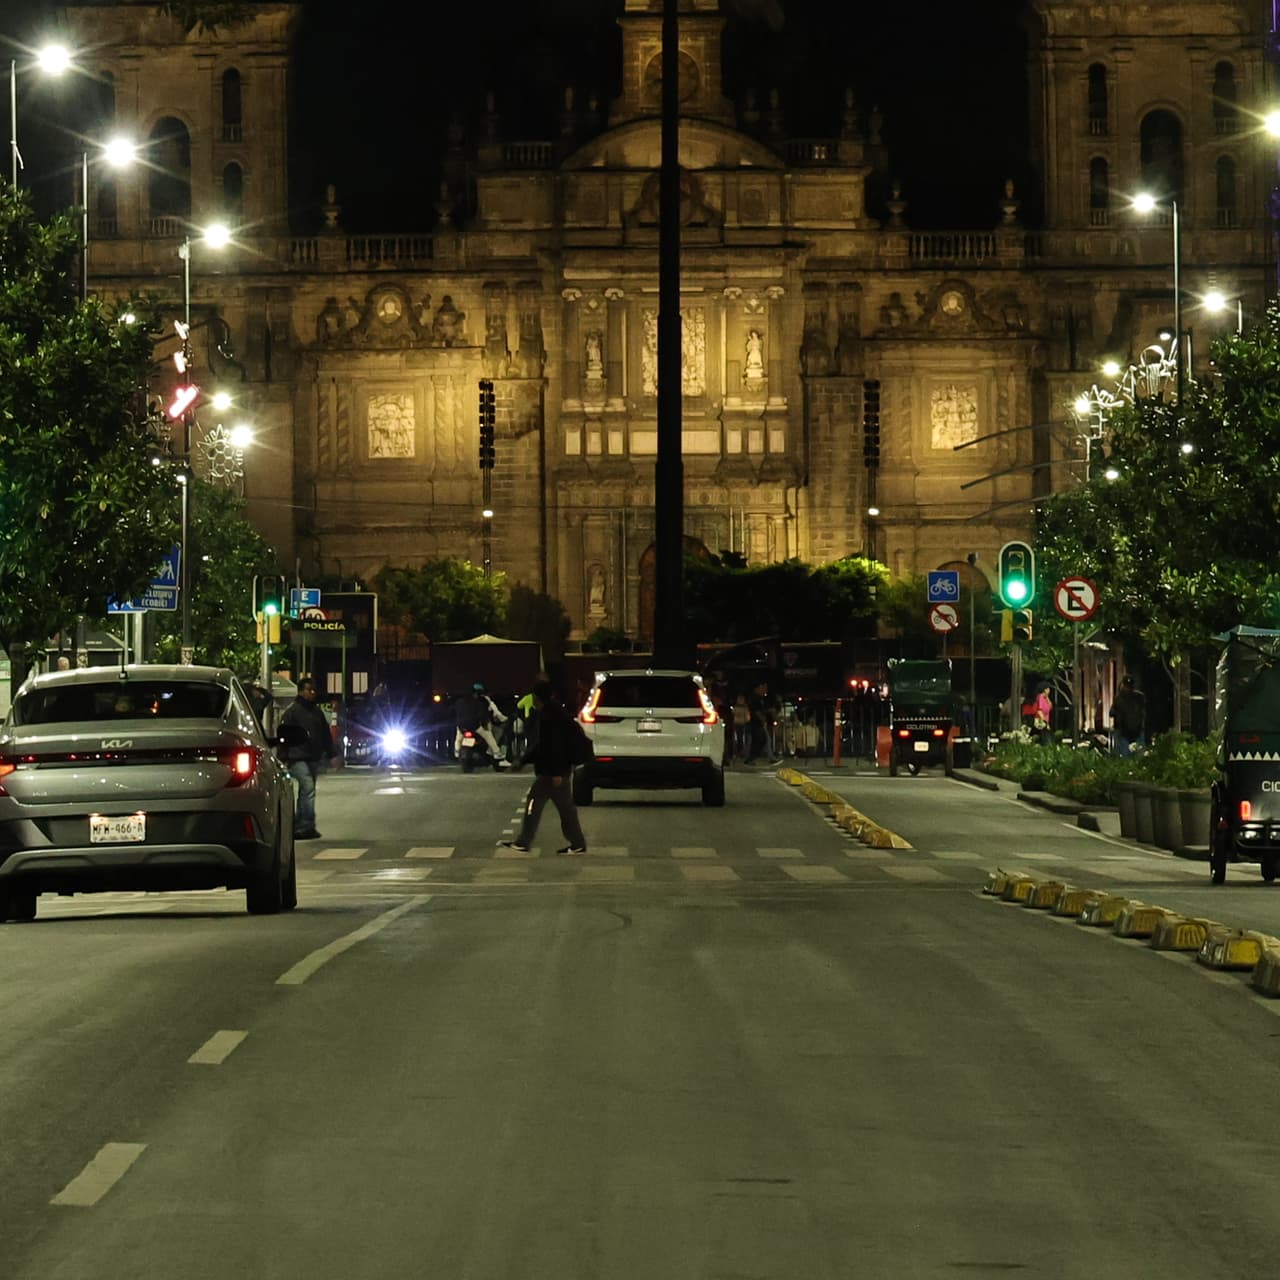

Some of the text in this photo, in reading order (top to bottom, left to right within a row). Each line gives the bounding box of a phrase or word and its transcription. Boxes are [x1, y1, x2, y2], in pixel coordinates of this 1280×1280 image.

[1067, 586, 1085, 611] E
[303, 622, 347, 631] POLICÍA
[101, 739, 133, 749] KIA
